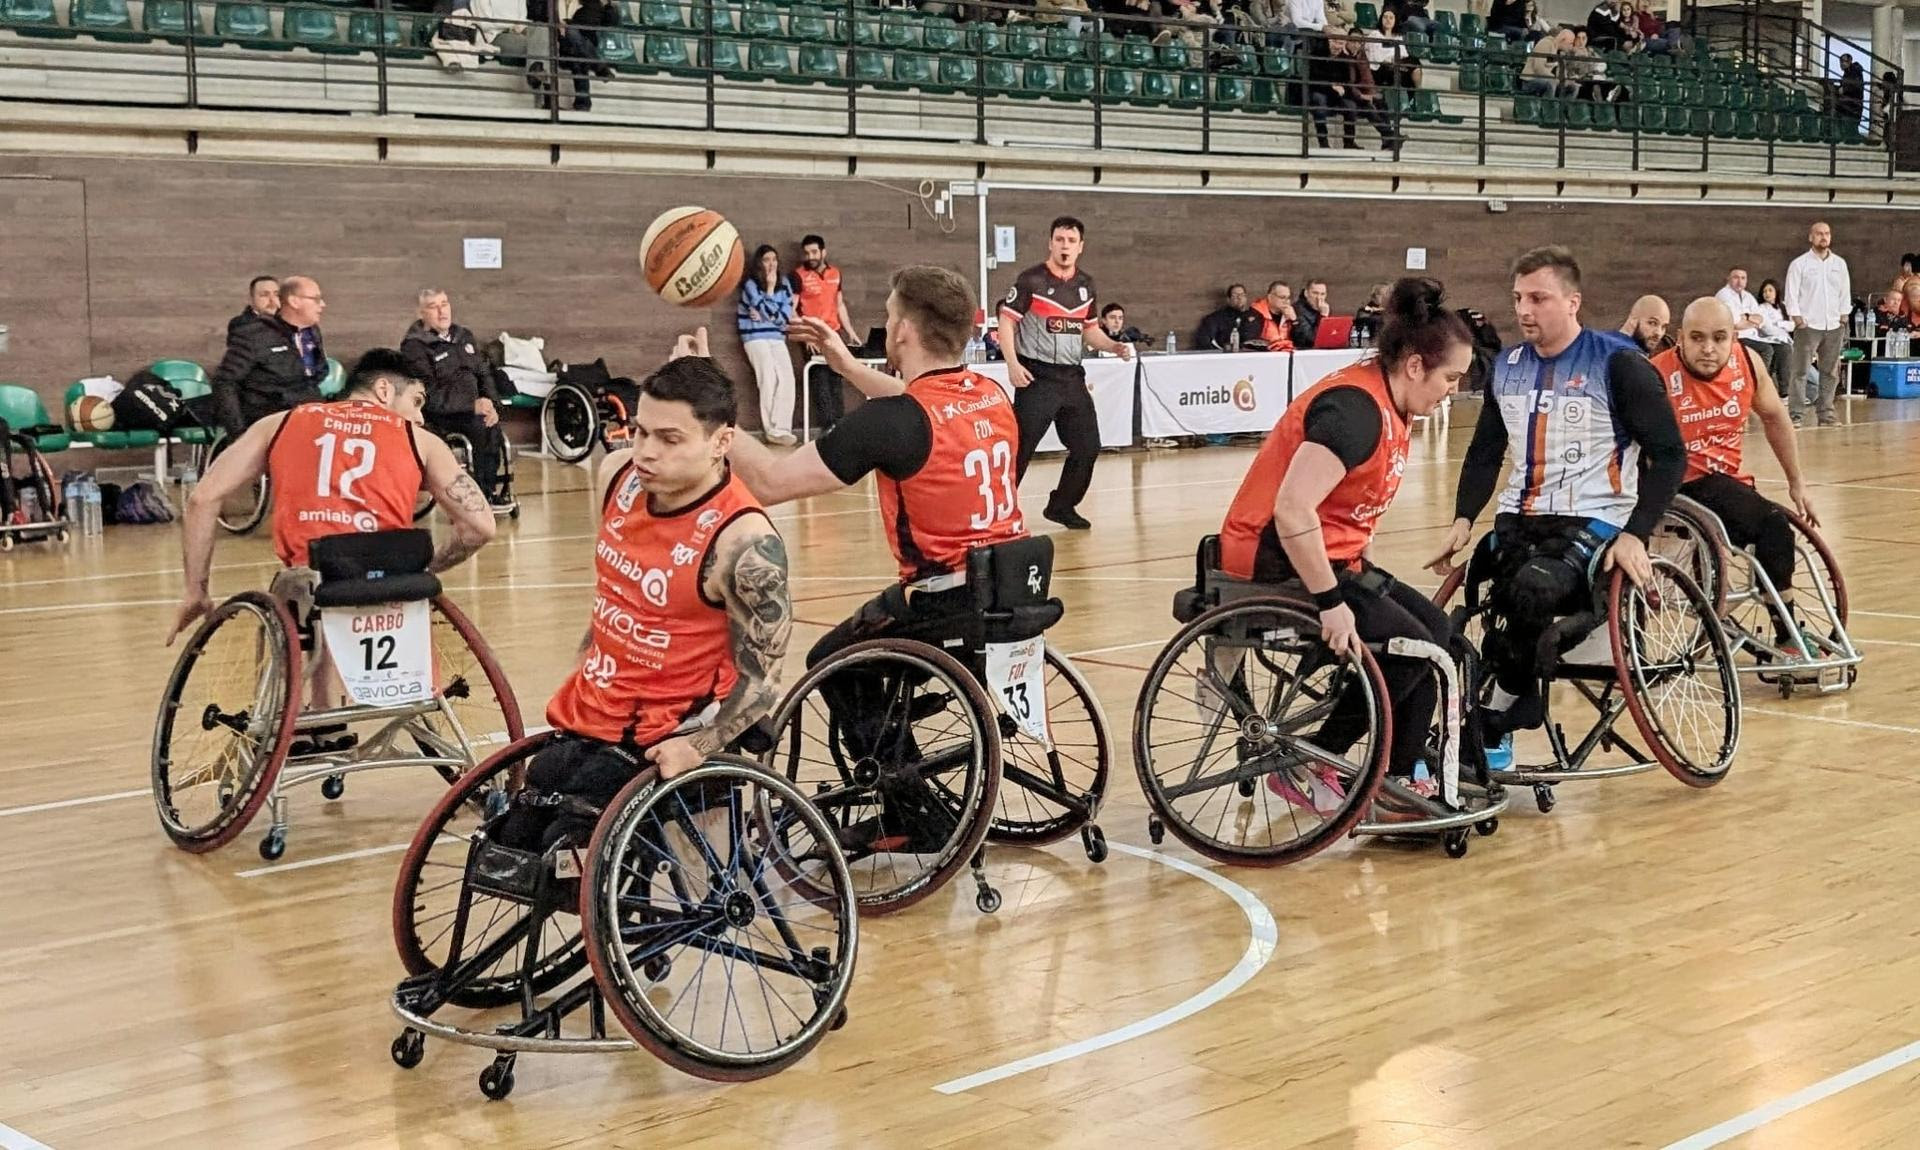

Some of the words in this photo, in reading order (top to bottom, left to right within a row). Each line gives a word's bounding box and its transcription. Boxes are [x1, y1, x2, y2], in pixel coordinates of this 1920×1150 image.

[675, 244, 723, 298] Baden
[1528, 389, 1554, 414] 15
[323, 417, 373, 435] CARBÓ
[974, 418, 994, 441] FOX
[314, 432, 376, 505] 12
[963, 440, 1014, 530] 33
[359, 635, 399, 672] 12
[1008, 662, 1028, 682] FOX
[353, 681, 423, 700] gaviota
[1003, 682, 1030, 721] 33
